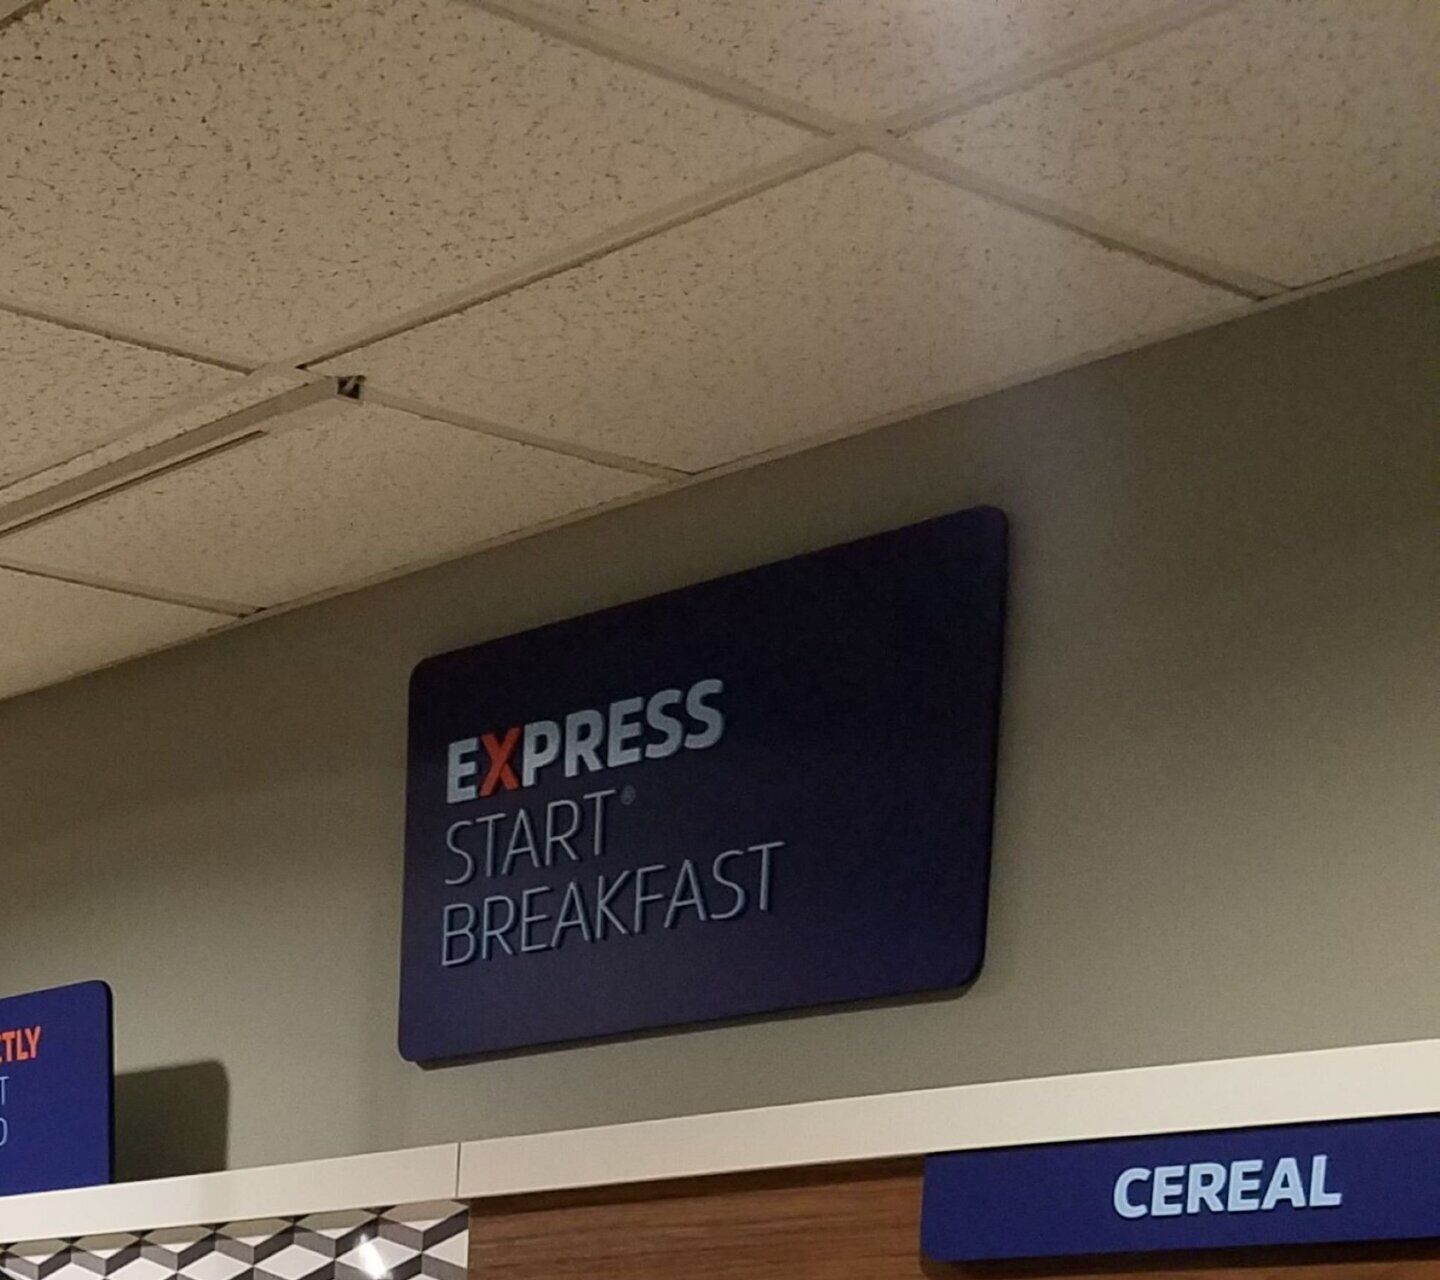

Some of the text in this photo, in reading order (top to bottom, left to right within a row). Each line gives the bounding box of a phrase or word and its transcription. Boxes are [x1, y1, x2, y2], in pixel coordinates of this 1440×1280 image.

[446, 677, 725, 804] EXPRESS
[440, 840, 786, 967] BREAKFAST
[1112, 1154, 1343, 1220] CEREAL
